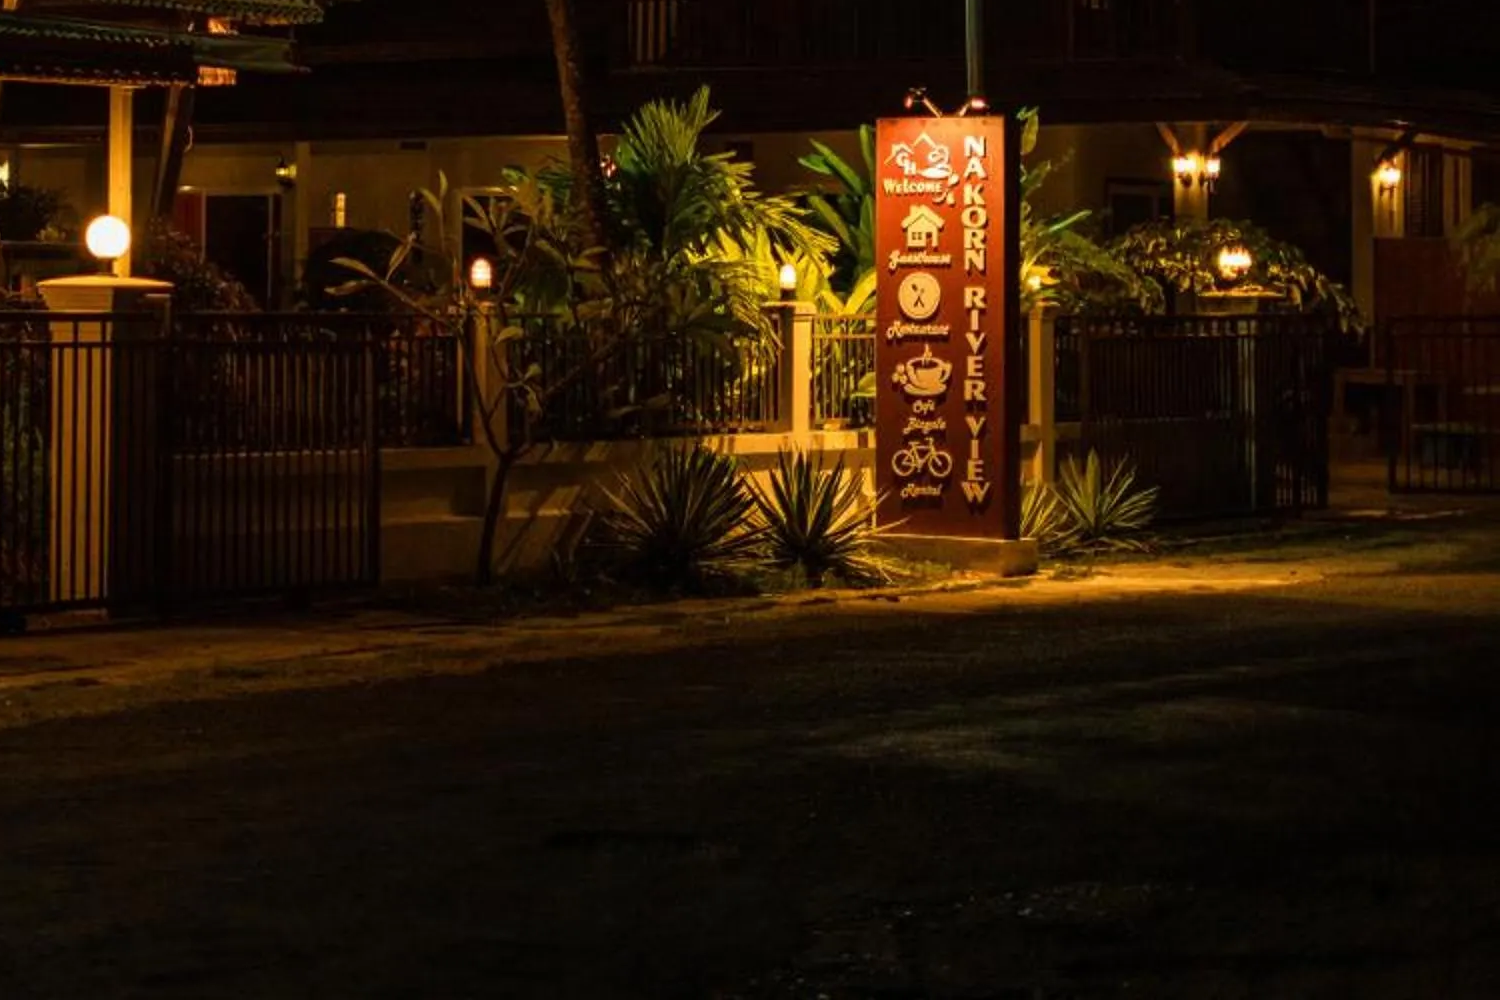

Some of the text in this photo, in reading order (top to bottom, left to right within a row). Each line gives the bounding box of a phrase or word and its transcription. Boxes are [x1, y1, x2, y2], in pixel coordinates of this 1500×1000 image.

[960, 136, 990, 503] NAKORN RIVER VIEW
